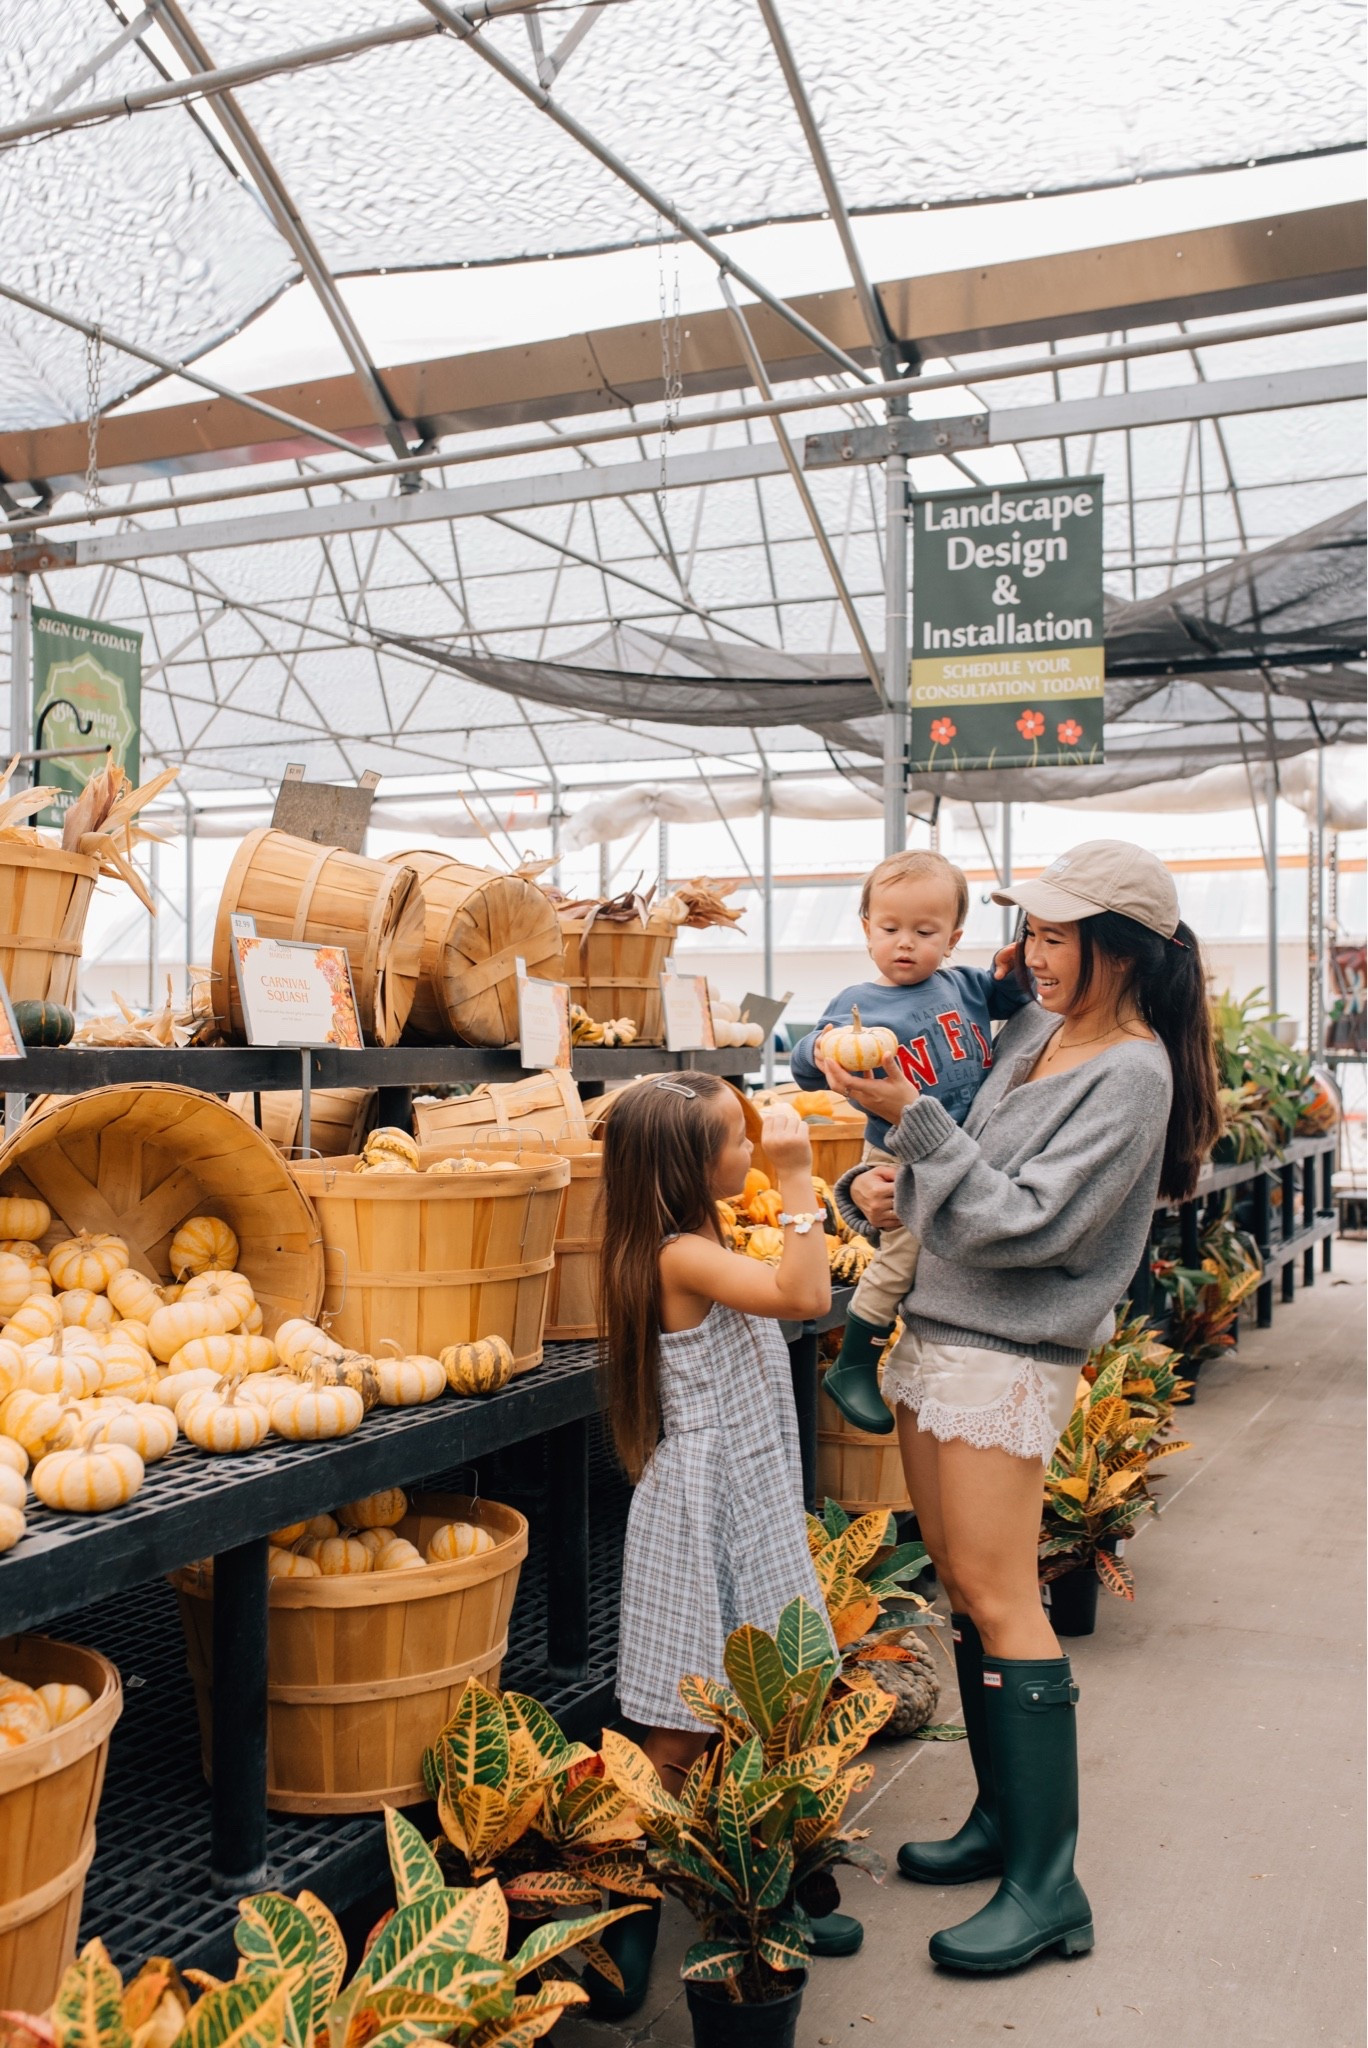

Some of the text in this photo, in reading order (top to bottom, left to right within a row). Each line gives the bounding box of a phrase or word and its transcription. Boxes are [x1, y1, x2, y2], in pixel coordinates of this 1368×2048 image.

[925, 491, 1093, 532] Landscape
[947, 530, 1068, 578] Design
[991, 574, 1021, 606] &
[38, 617, 138, 654] SIGN UP TODAY!
[924, 611, 1092, 650] Installation
[942, 657, 1070, 680] SCHEDULE YOUR
[915, 675, 1100, 701] CONSULTATION TODAY!
[69, 721, 121, 742] RARDS
[234, 919, 250, 928] $2.99
[260, 975, 311, 990] CARNIVAL
[267, 989, 309, 1004] SQUASH
